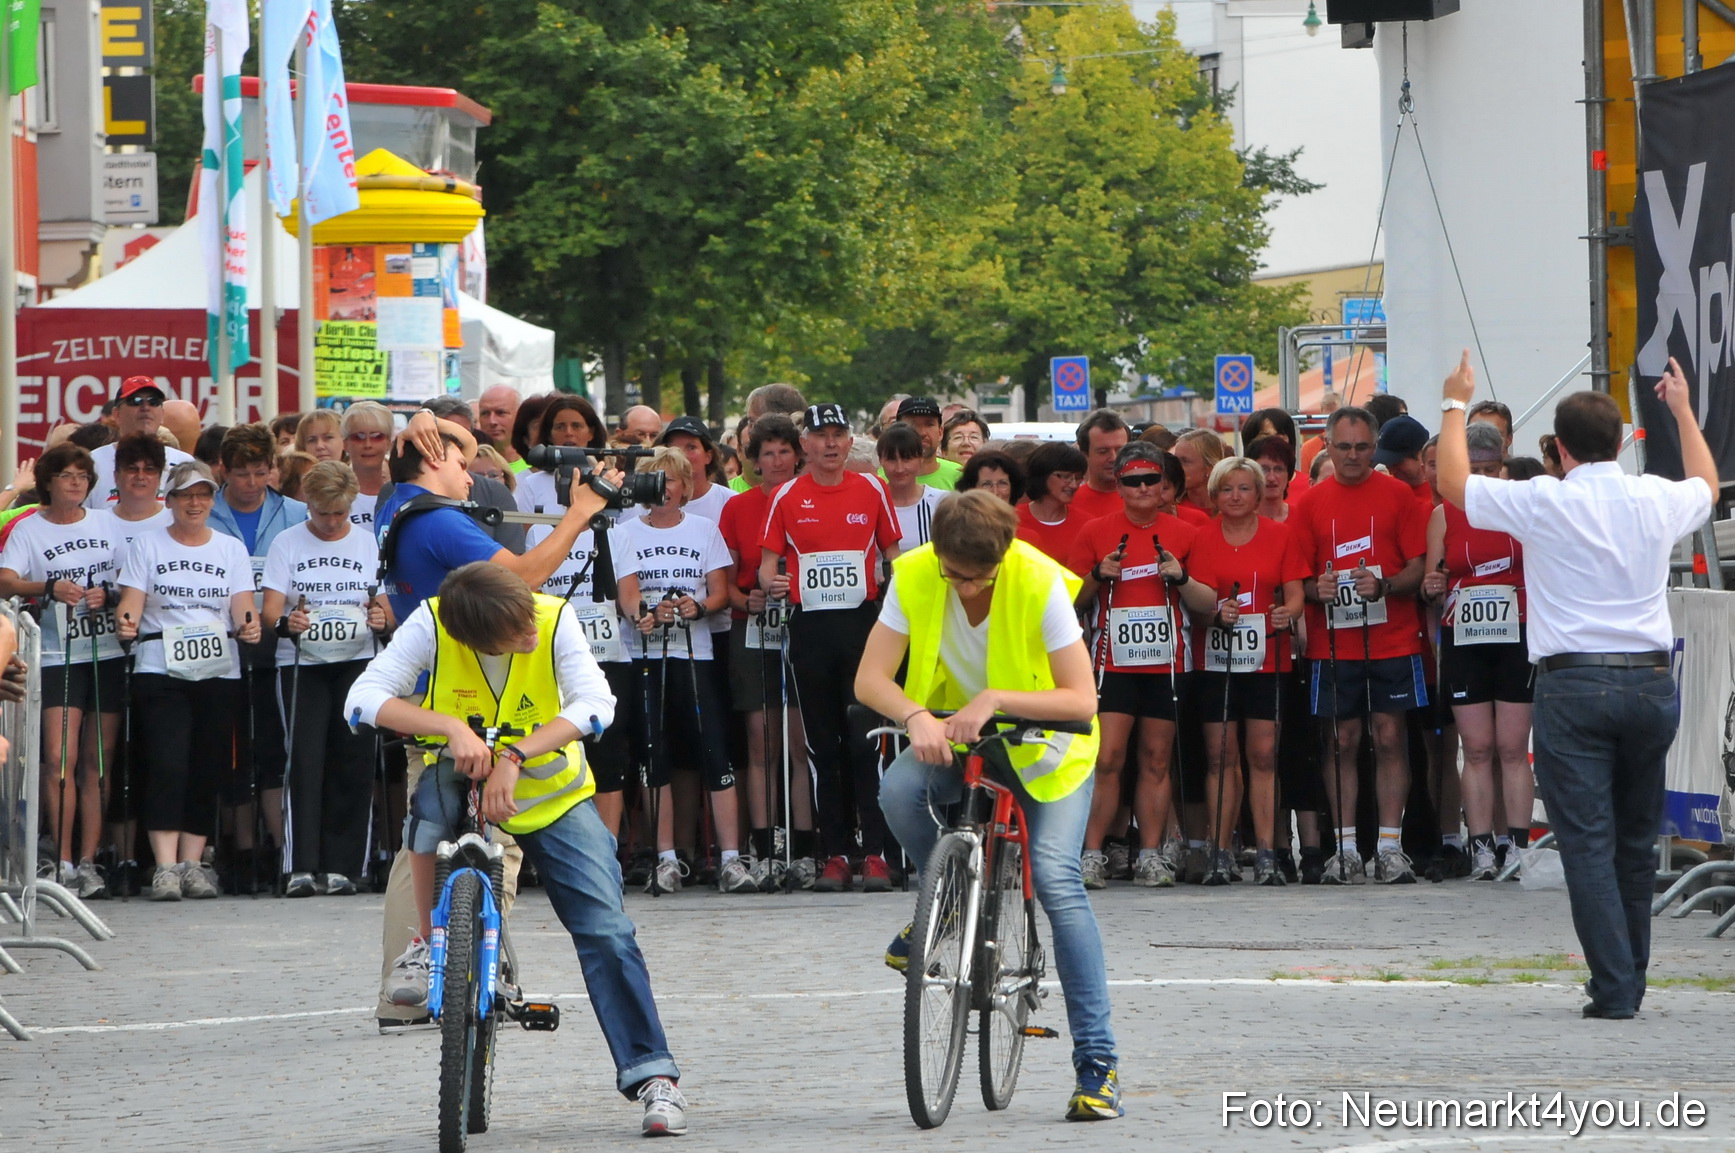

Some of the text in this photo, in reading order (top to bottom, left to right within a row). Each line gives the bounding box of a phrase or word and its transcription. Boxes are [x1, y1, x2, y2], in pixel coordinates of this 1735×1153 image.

[1638, 161, 1735, 430] Xpl
[52, 335, 209, 364] ZELTVERLEI
[17, 374, 264, 424] EICNER
[1056, 395, 1088, 407] TAXI
[1219, 396, 1252, 409] TAXI
[43, 538, 109, 561] BERGER
[1345, 542, 1362, 551] DEHN
[157, 560, 226, 578] BERGER
[297, 556, 363, 573] BERGER
[1131, 568, 1149, 576] DEHN
[1484, 563, 1501, 571] DEHN
[638, 569, 703, 580] OWER GIRLS
[807, 567, 858, 589] 8055
[154, 583, 230, 598] POWER GIRLS
[292, 580, 369, 592] POWER GIRLS
[821, 592, 846, 602] Horst
[1345, 611, 1364, 620] Jose
[1461, 600, 1510, 624] 8007
[308, 621, 358, 641] 8087
[581, 618, 613, 641] 13
[764, 632, 782, 642] Sab
[1118, 621, 1170, 645] 8039
[1465, 627, 1507, 638] Marianne
[1211, 629, 1259, 651] 8019
[173, 636, 223, 661] 8089
[589, 645, 606, 654] itte
[1128, 647, 1162, 660] Brigitte
